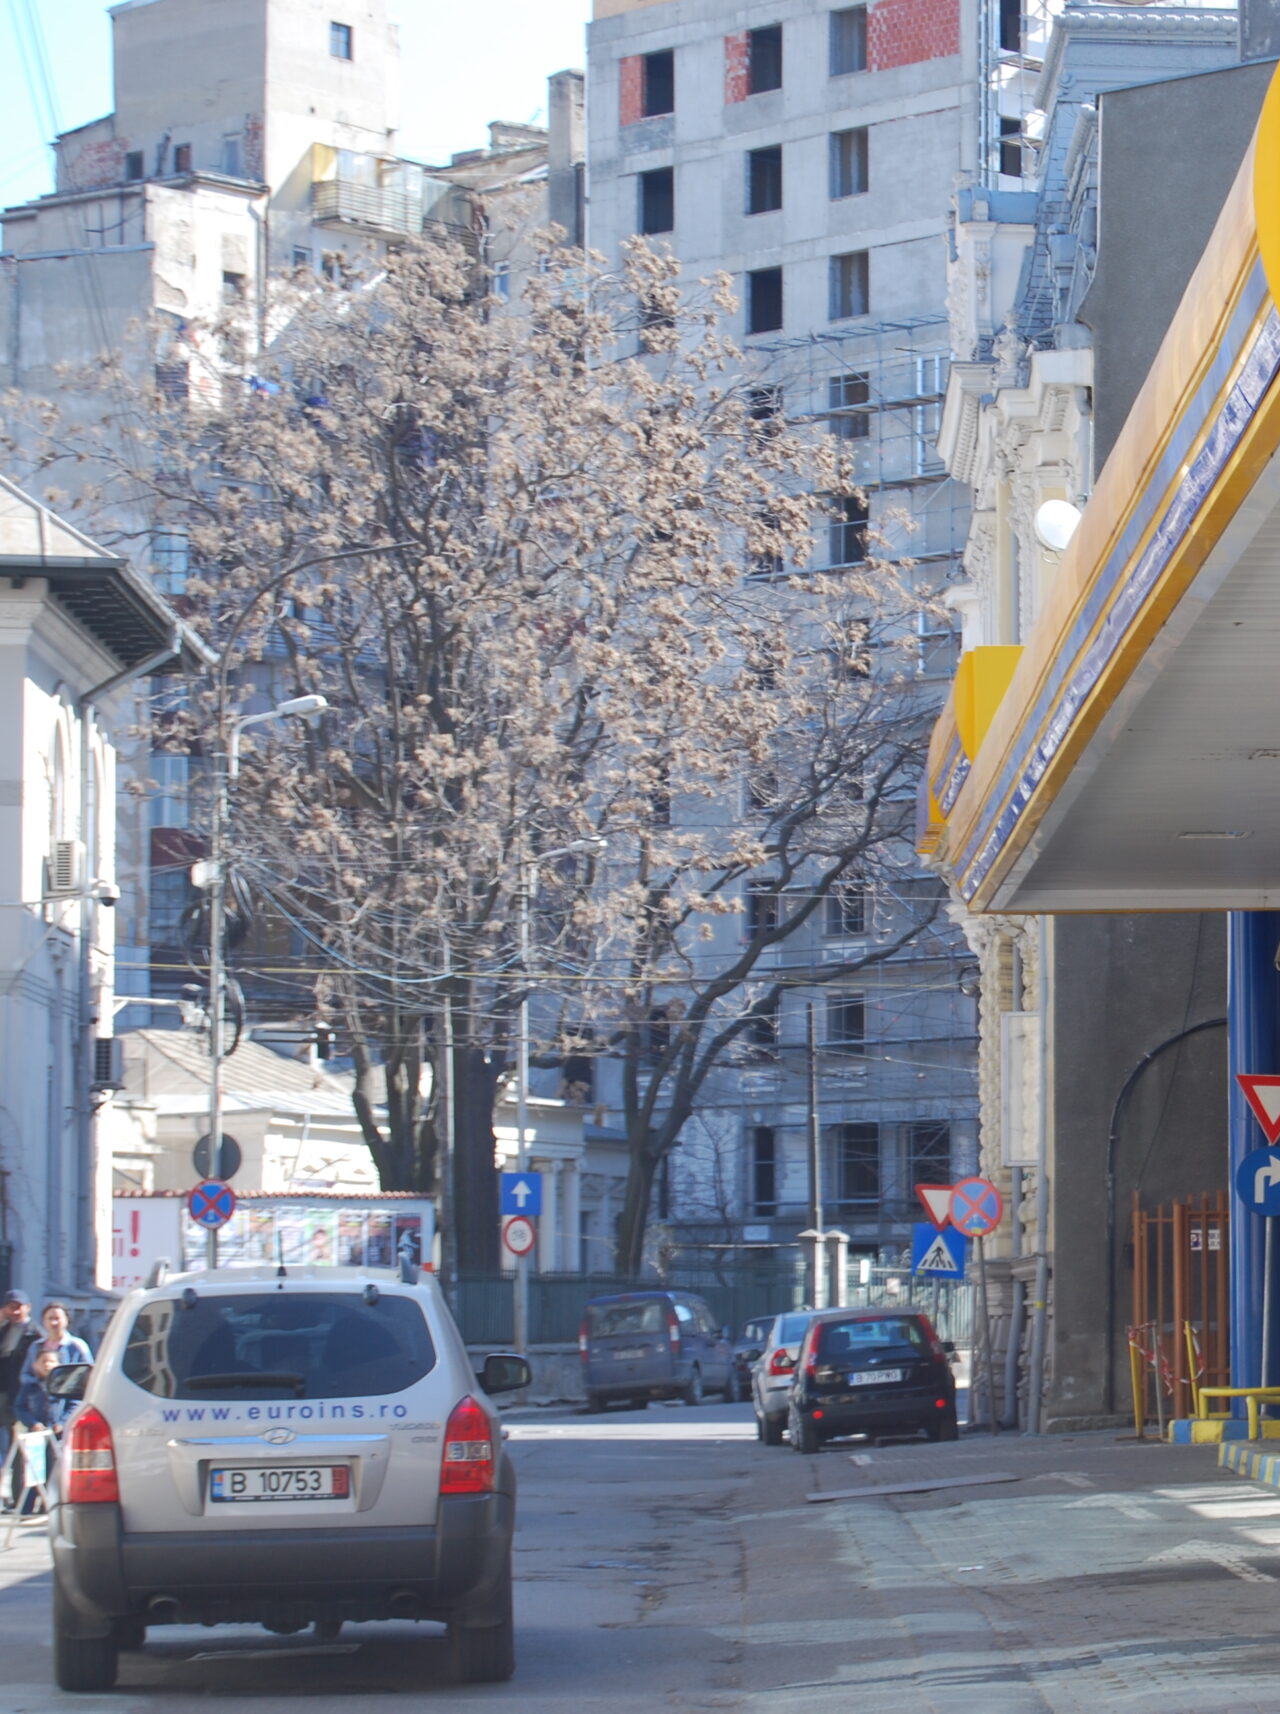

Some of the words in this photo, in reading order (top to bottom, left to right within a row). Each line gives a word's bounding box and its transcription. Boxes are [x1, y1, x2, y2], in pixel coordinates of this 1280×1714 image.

[162, 1402, 407, 1422] www.euroins.ro
[231, 1472, 247, 1493] B
[260, 1470, 322, 1493] 10753
